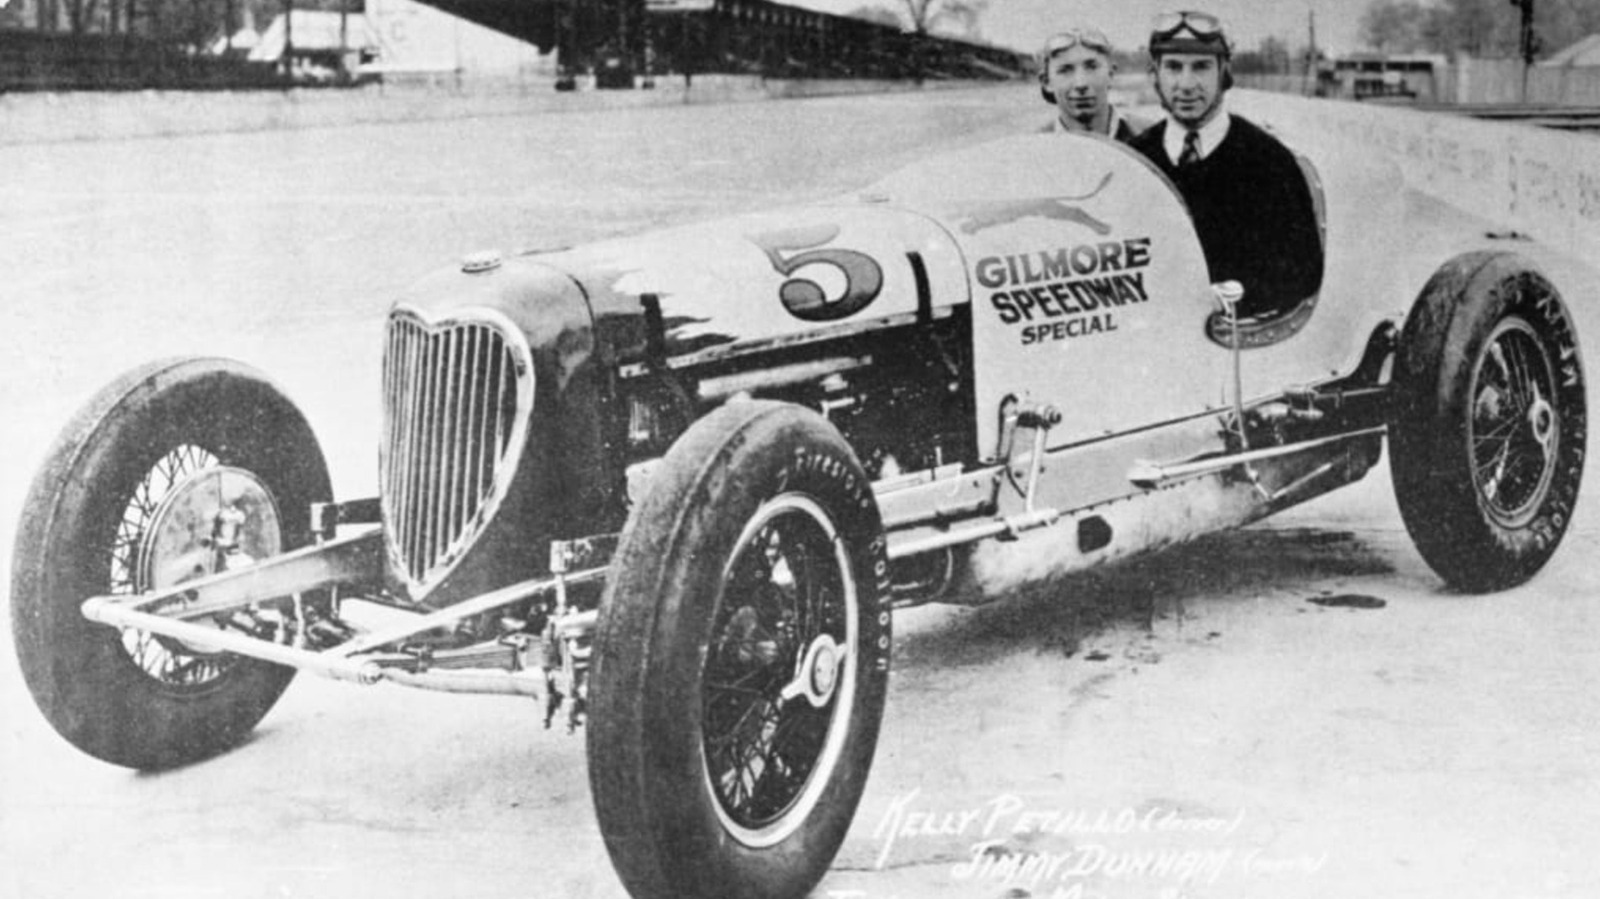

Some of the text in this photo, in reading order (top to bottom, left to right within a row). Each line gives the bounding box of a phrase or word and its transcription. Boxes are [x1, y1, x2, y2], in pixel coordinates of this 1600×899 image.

[745, 223, 884, 323] 5
[975, 237, 1152, 288] GILMORE
[990, 272, 1149, 325] SPEEDWAY
[1020, 313, 1119, 346] SPECIAL
